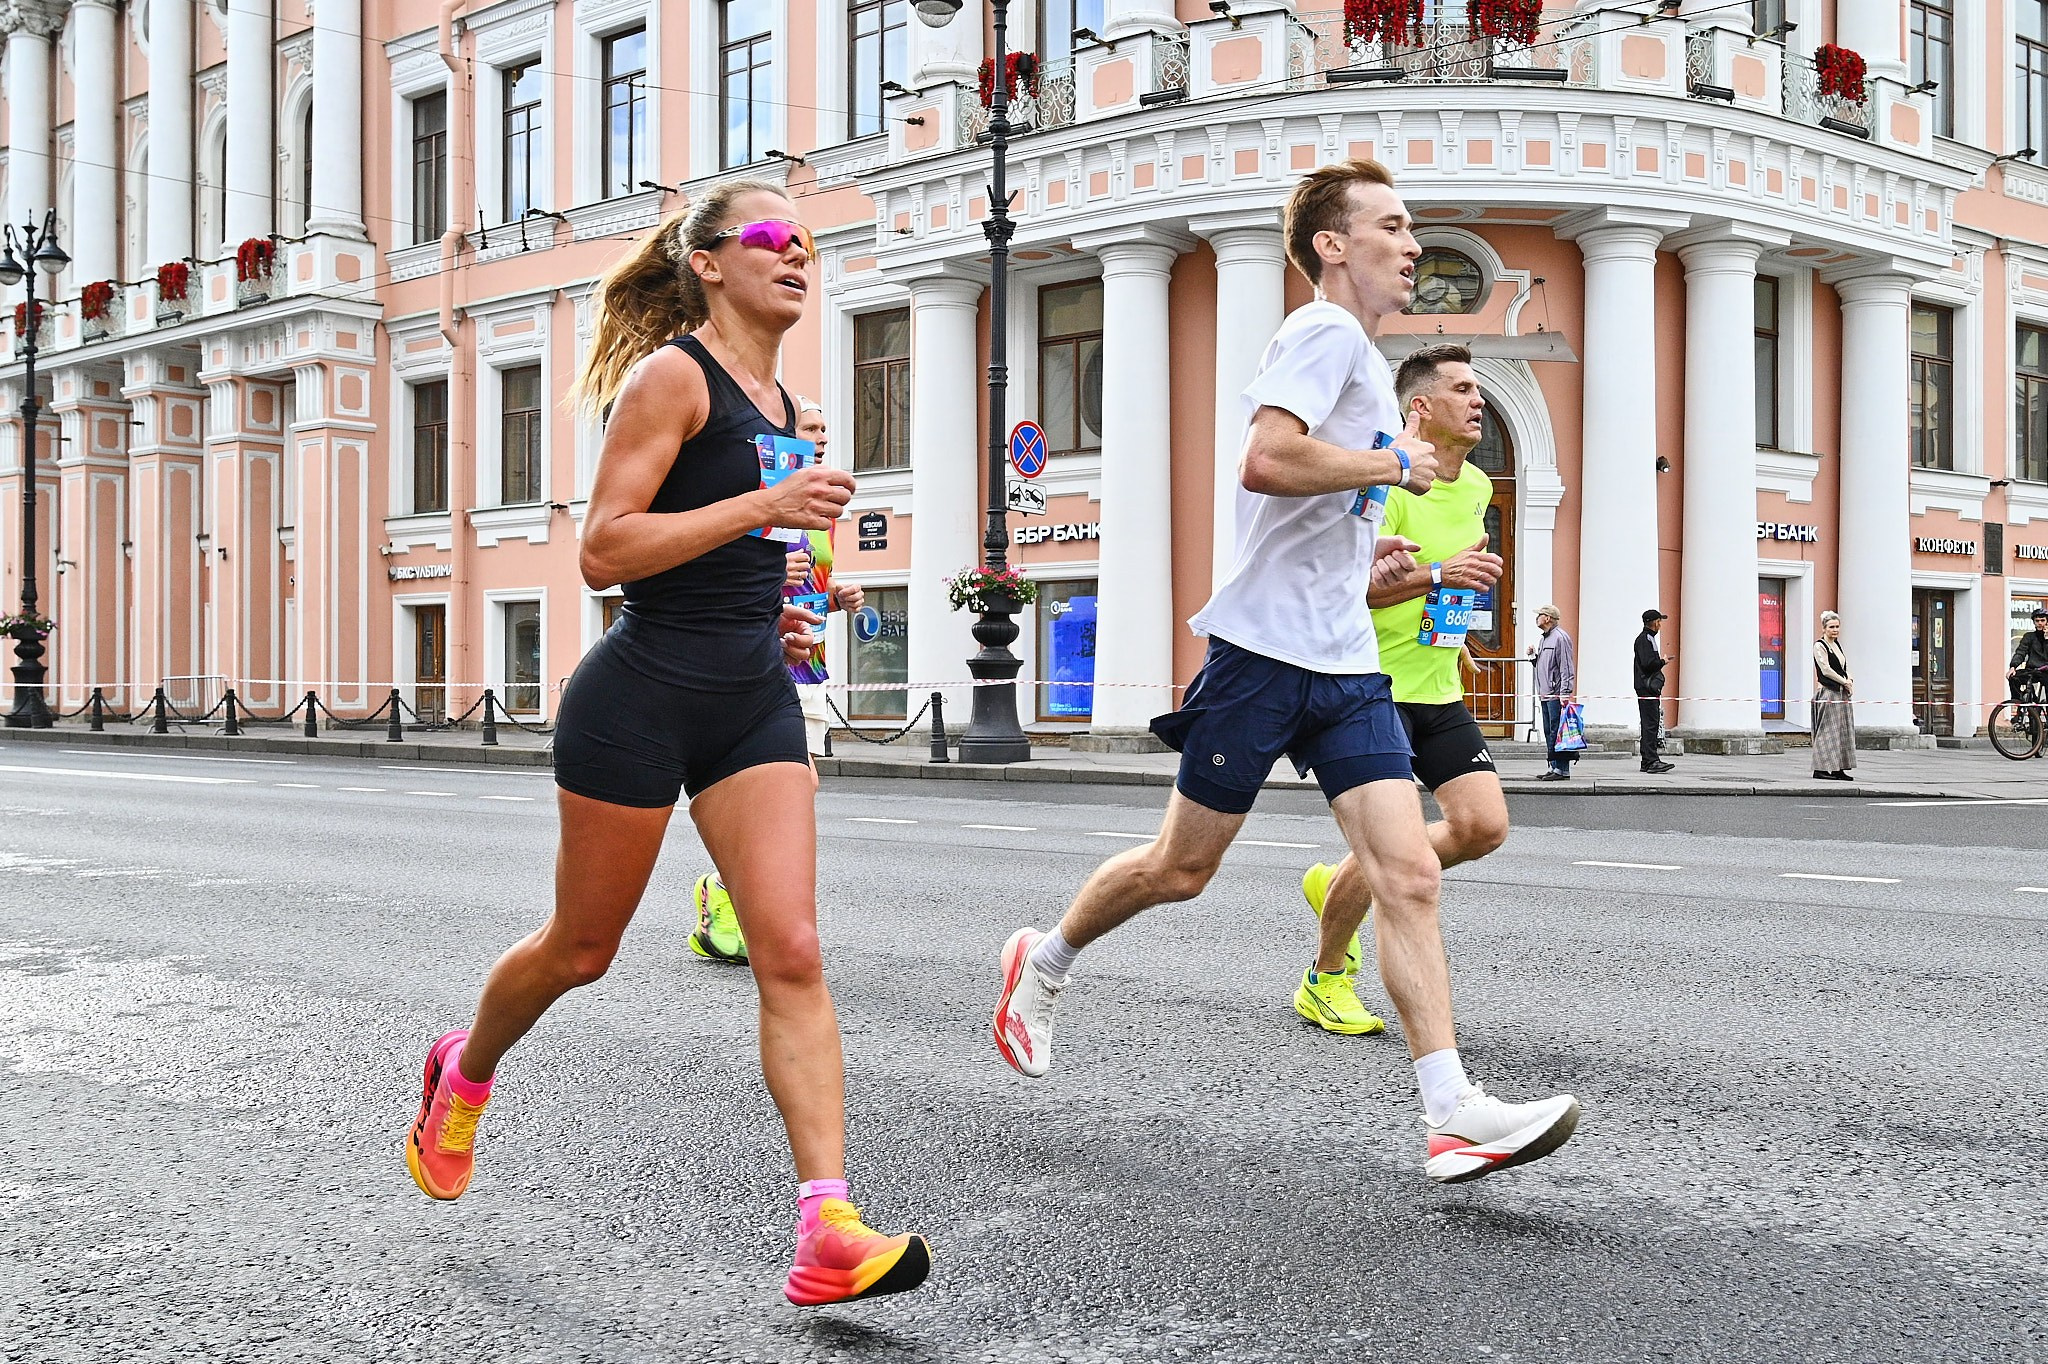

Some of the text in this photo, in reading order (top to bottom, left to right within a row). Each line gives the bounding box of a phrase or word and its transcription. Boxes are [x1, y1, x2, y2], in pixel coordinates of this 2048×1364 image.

[1013, 521, 1100, 544] ББР БАНК
[1777, 523, 1819, 542] БАНК
[1919, 537, 1977, 555] КОНФЕТЫ
